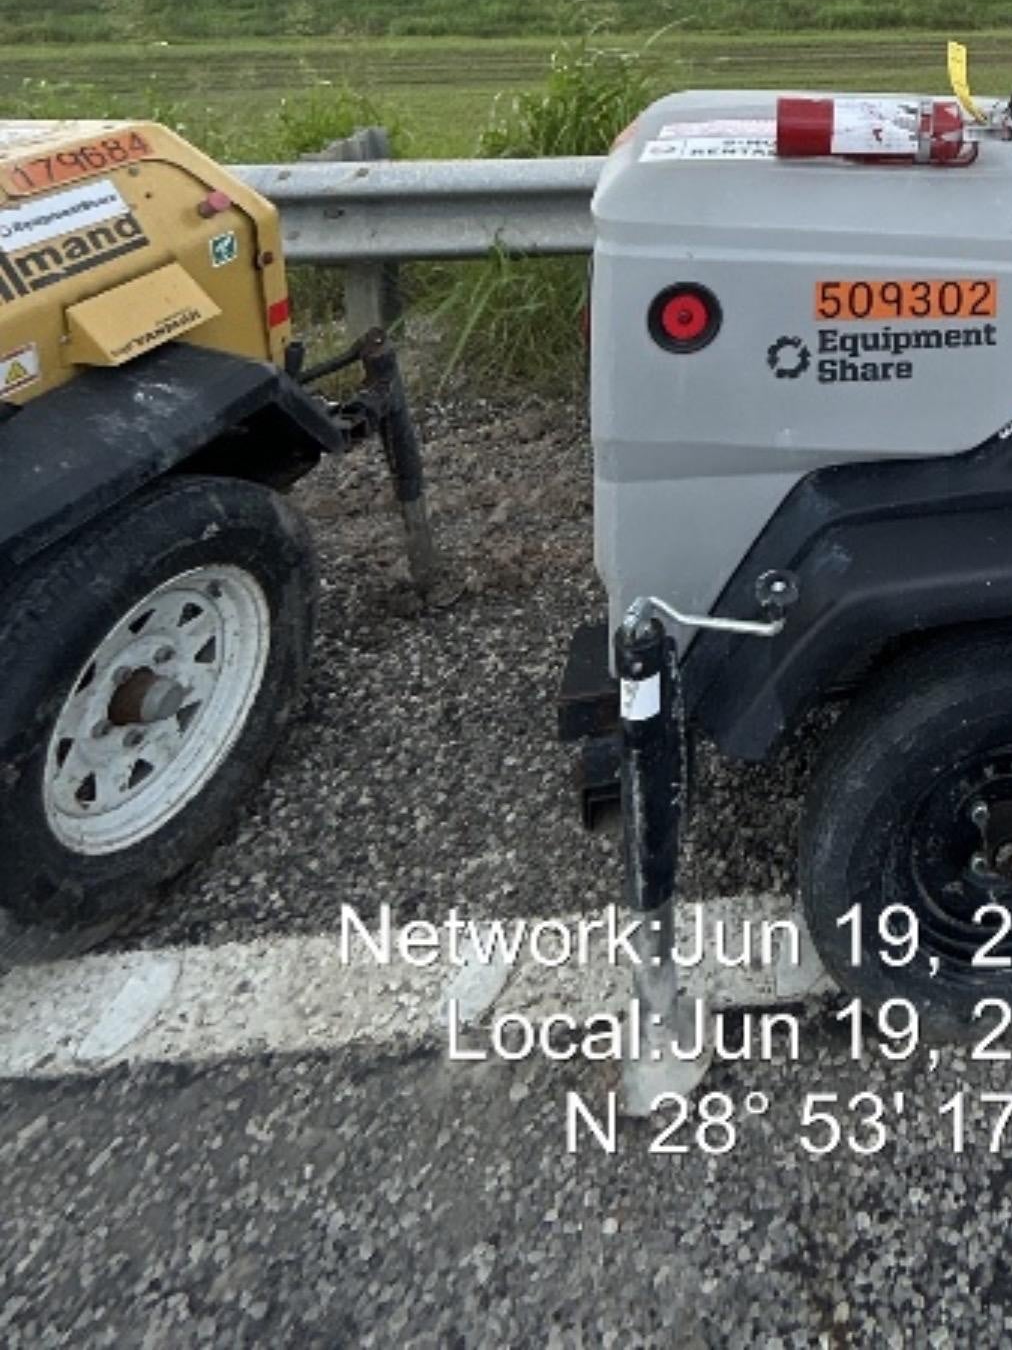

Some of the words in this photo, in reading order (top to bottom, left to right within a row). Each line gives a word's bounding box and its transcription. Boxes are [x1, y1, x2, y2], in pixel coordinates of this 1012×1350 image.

[11, 131, 149, 188] 179684
[818, 281, 992, 318] 509302
[818, 323, 997, 357] Equipment
[817, 358, 913, 384] Share
